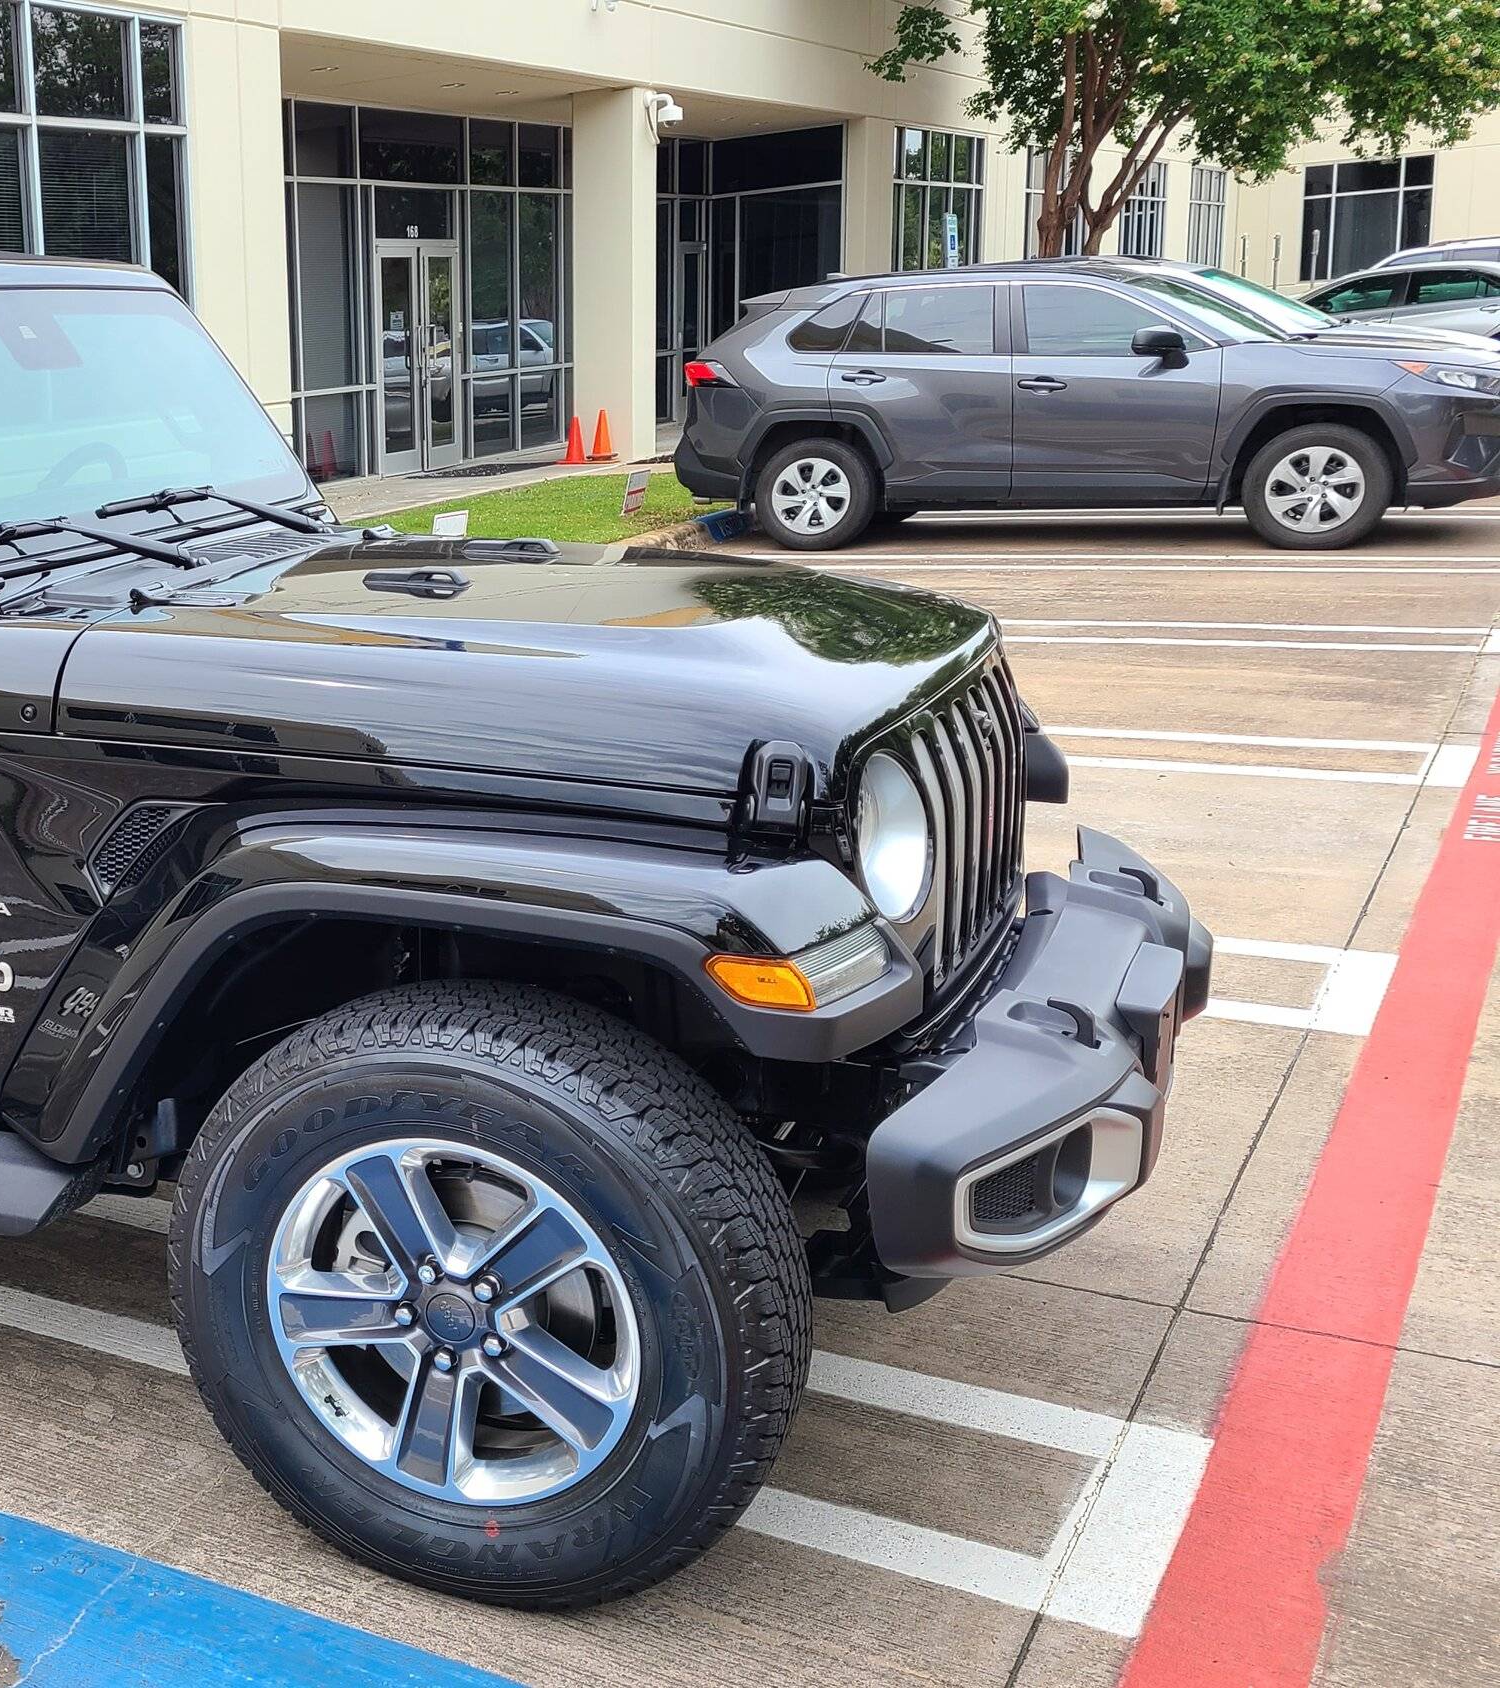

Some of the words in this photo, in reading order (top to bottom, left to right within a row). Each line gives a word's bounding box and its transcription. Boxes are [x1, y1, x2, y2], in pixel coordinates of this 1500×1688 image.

[406, 225, 419, 238] 168
[243, 1088, 598, 1192] GOODYEAR
[301, 1466, 653, 1567] WRANGLER
